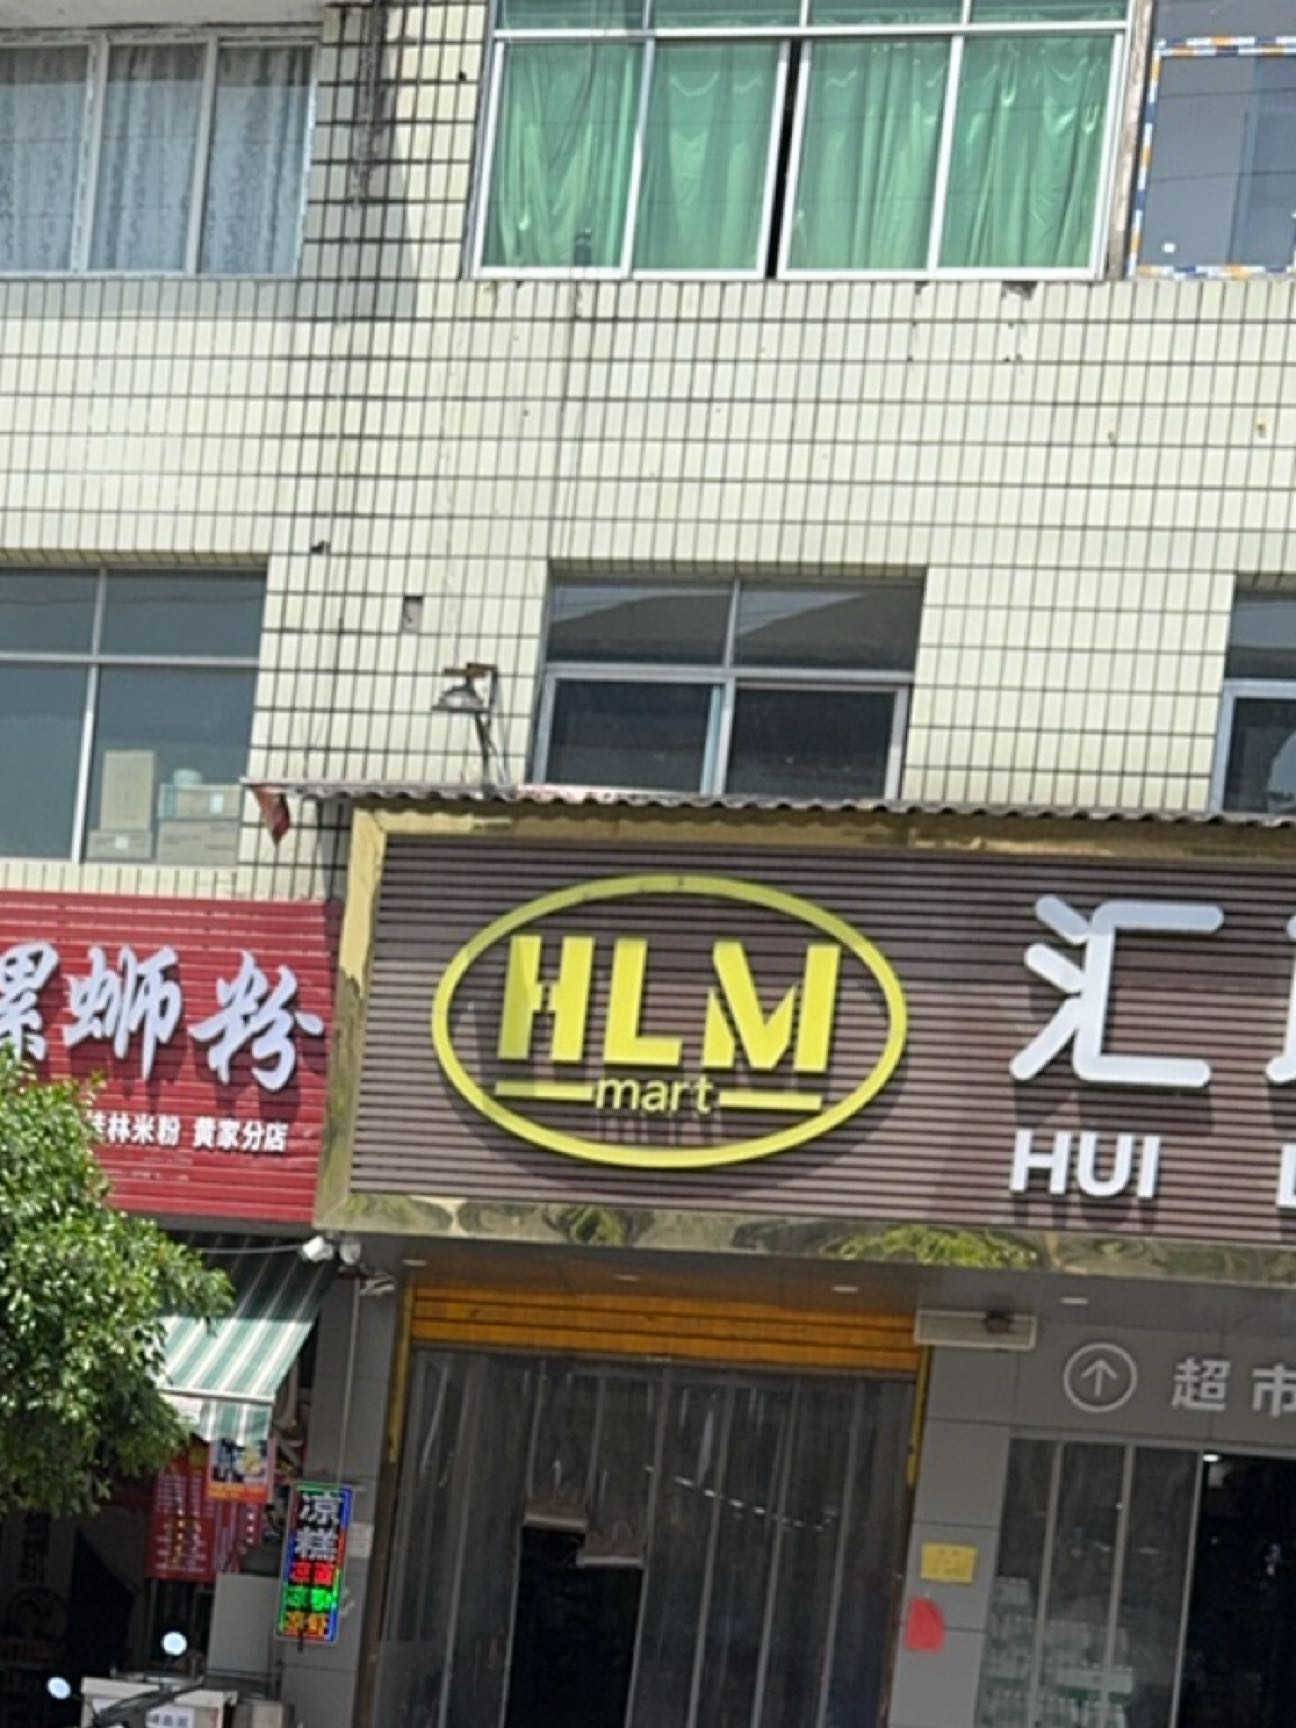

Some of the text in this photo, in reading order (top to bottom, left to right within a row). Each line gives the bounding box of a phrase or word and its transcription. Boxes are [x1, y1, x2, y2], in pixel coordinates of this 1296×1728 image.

[496, 935, 841, 1073] HLM
[1009, 894, 1296, 1088] 汇
[594, 1073, 713, 1114] mart
[193, 1115, 289, 1152] 黄家分店
[1009, 1129, 1162, 1200] HUI
[1172, 1357, 1296, 1418] 超市
